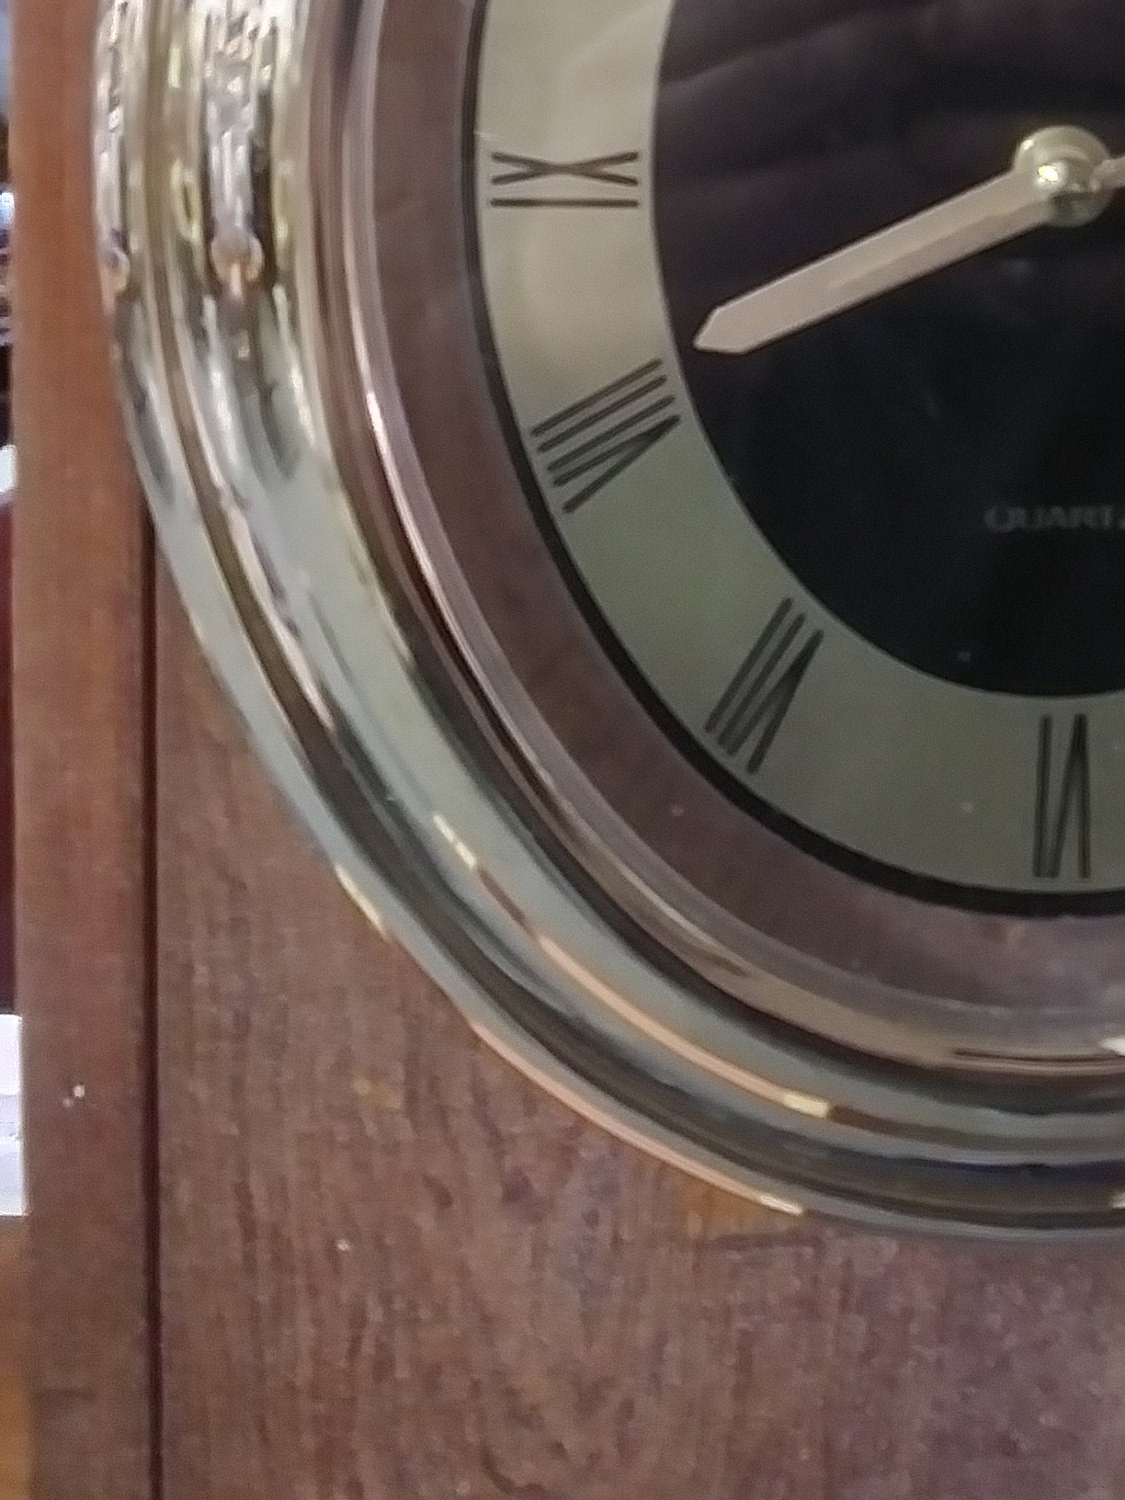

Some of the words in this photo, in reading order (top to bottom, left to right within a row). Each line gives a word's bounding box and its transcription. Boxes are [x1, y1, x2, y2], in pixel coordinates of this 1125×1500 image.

[490, 151, 640, 207] IX
[531, 357, 681, 513] VIII
[704, 597, 824, 775] VII
[1033, 712, 1092, 880] VI
